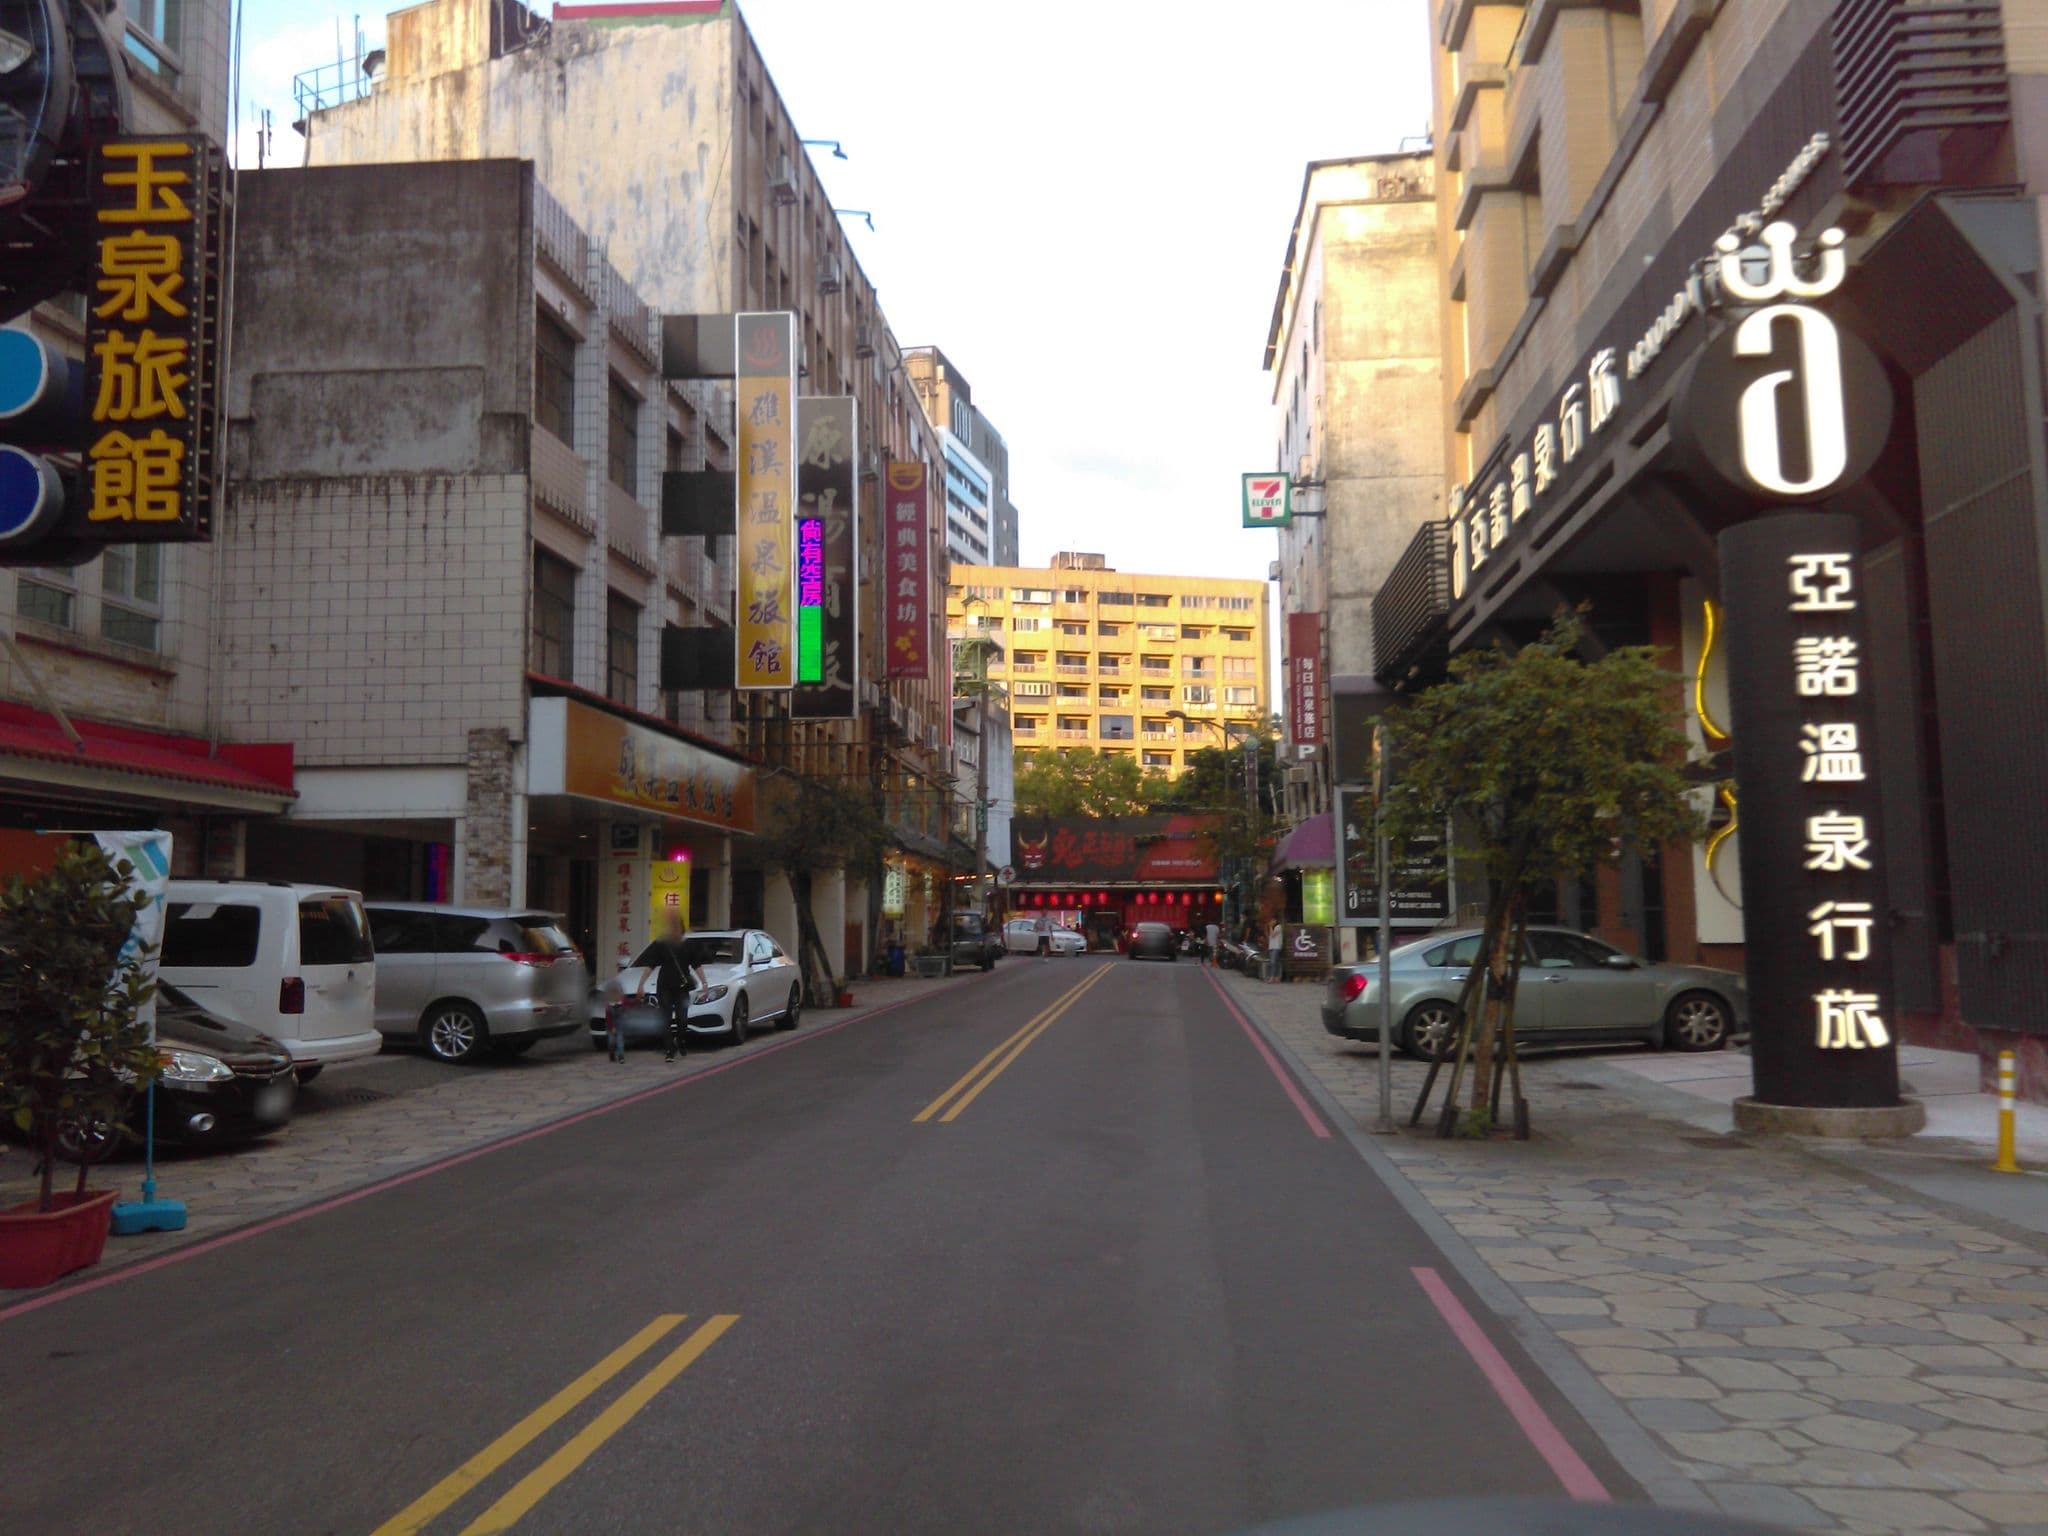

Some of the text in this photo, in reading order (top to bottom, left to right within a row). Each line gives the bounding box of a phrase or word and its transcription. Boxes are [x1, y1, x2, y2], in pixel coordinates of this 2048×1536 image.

[89, 142, 194, 522] 玉泉旅館
[896, 501, 918, 623] 經典美食坊
[1298, 745, 1316, 760] P
[1786, 552, 1889, 1050] 亞諾溫泉行旅
